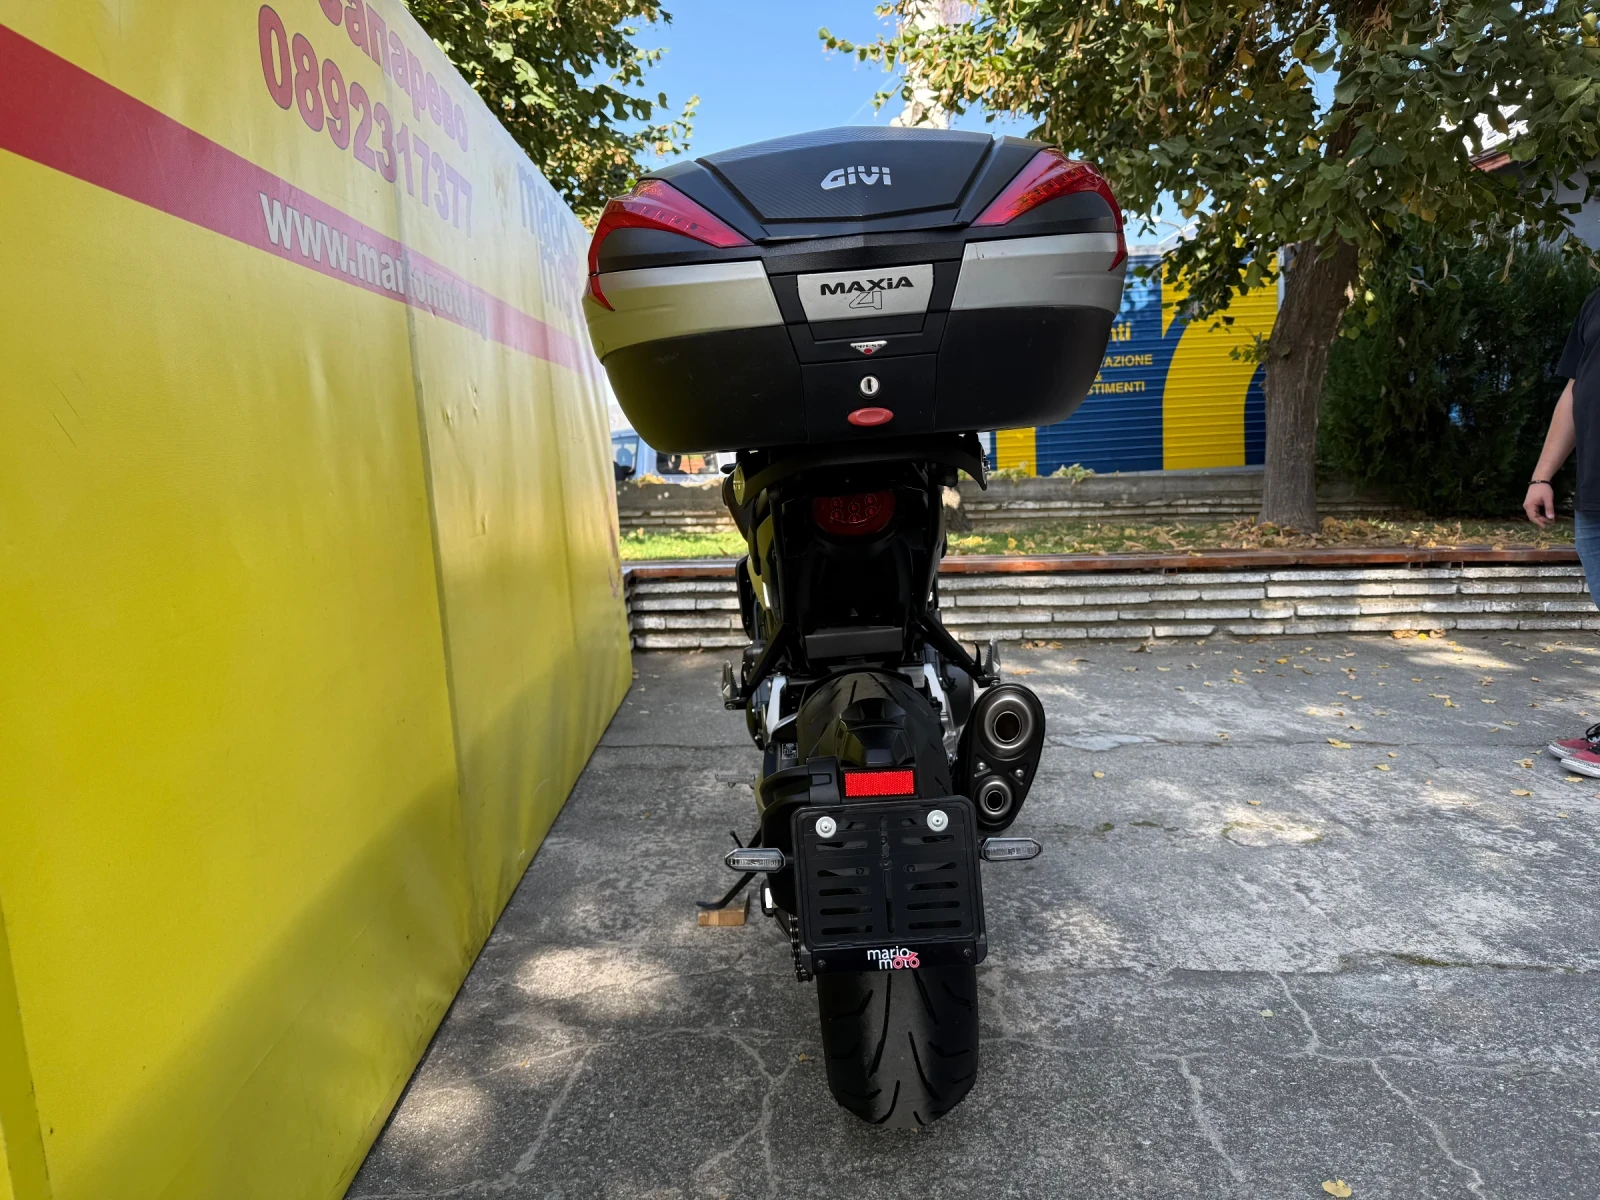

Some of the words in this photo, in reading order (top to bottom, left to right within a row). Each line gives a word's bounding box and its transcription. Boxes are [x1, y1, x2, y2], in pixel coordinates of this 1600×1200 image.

[318, 0, 469, 152] апарево
[258, 4, 472, 239] 0892317377
[820, 165, 892, 190] GIVI
[1101, 354, 1153, 367] AZIONE
[867, 945, 909, 960] mario
[879, 957, 920, 969] moto
